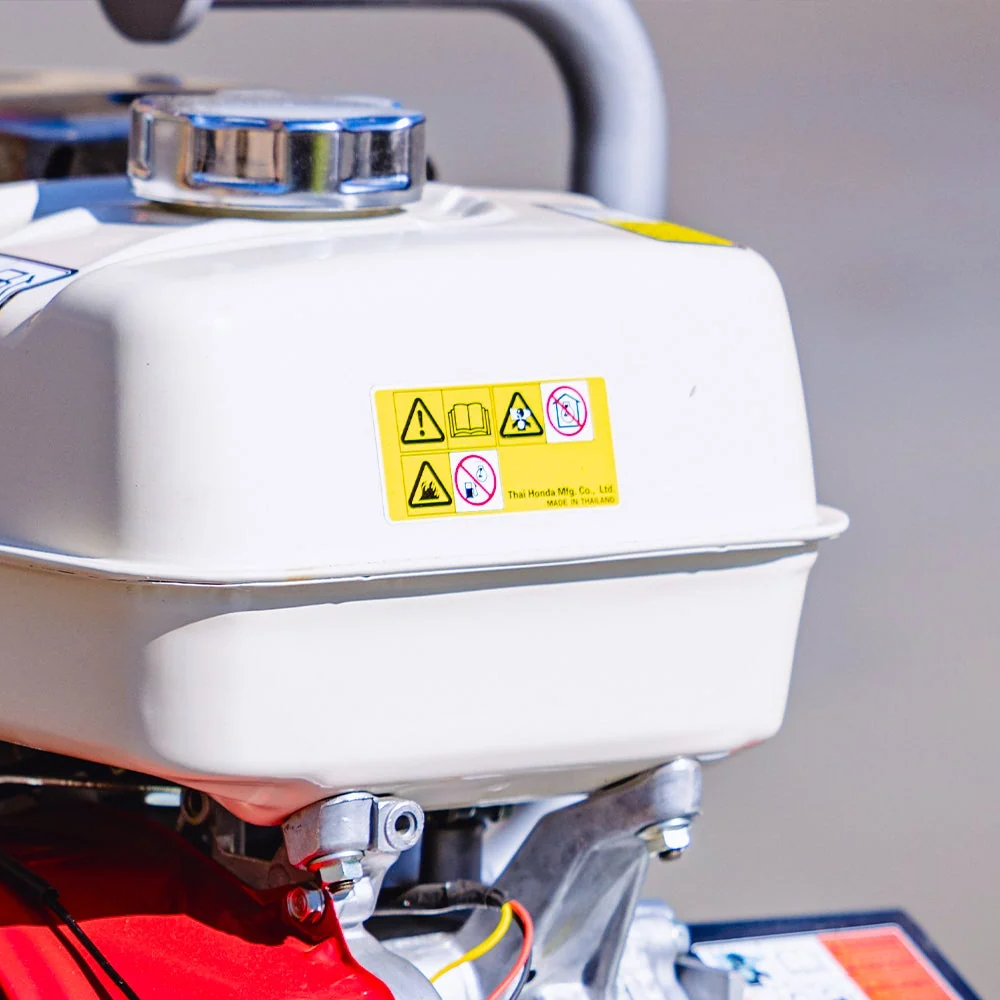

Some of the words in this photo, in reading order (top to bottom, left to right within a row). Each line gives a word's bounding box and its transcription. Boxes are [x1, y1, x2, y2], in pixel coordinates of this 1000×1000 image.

[508, 489, 526, 499] Thai
[528, 488, 556, 498] Honda
[547, 499, 567, 507] MADE
[581, 496, 616, 505] THAILAND
